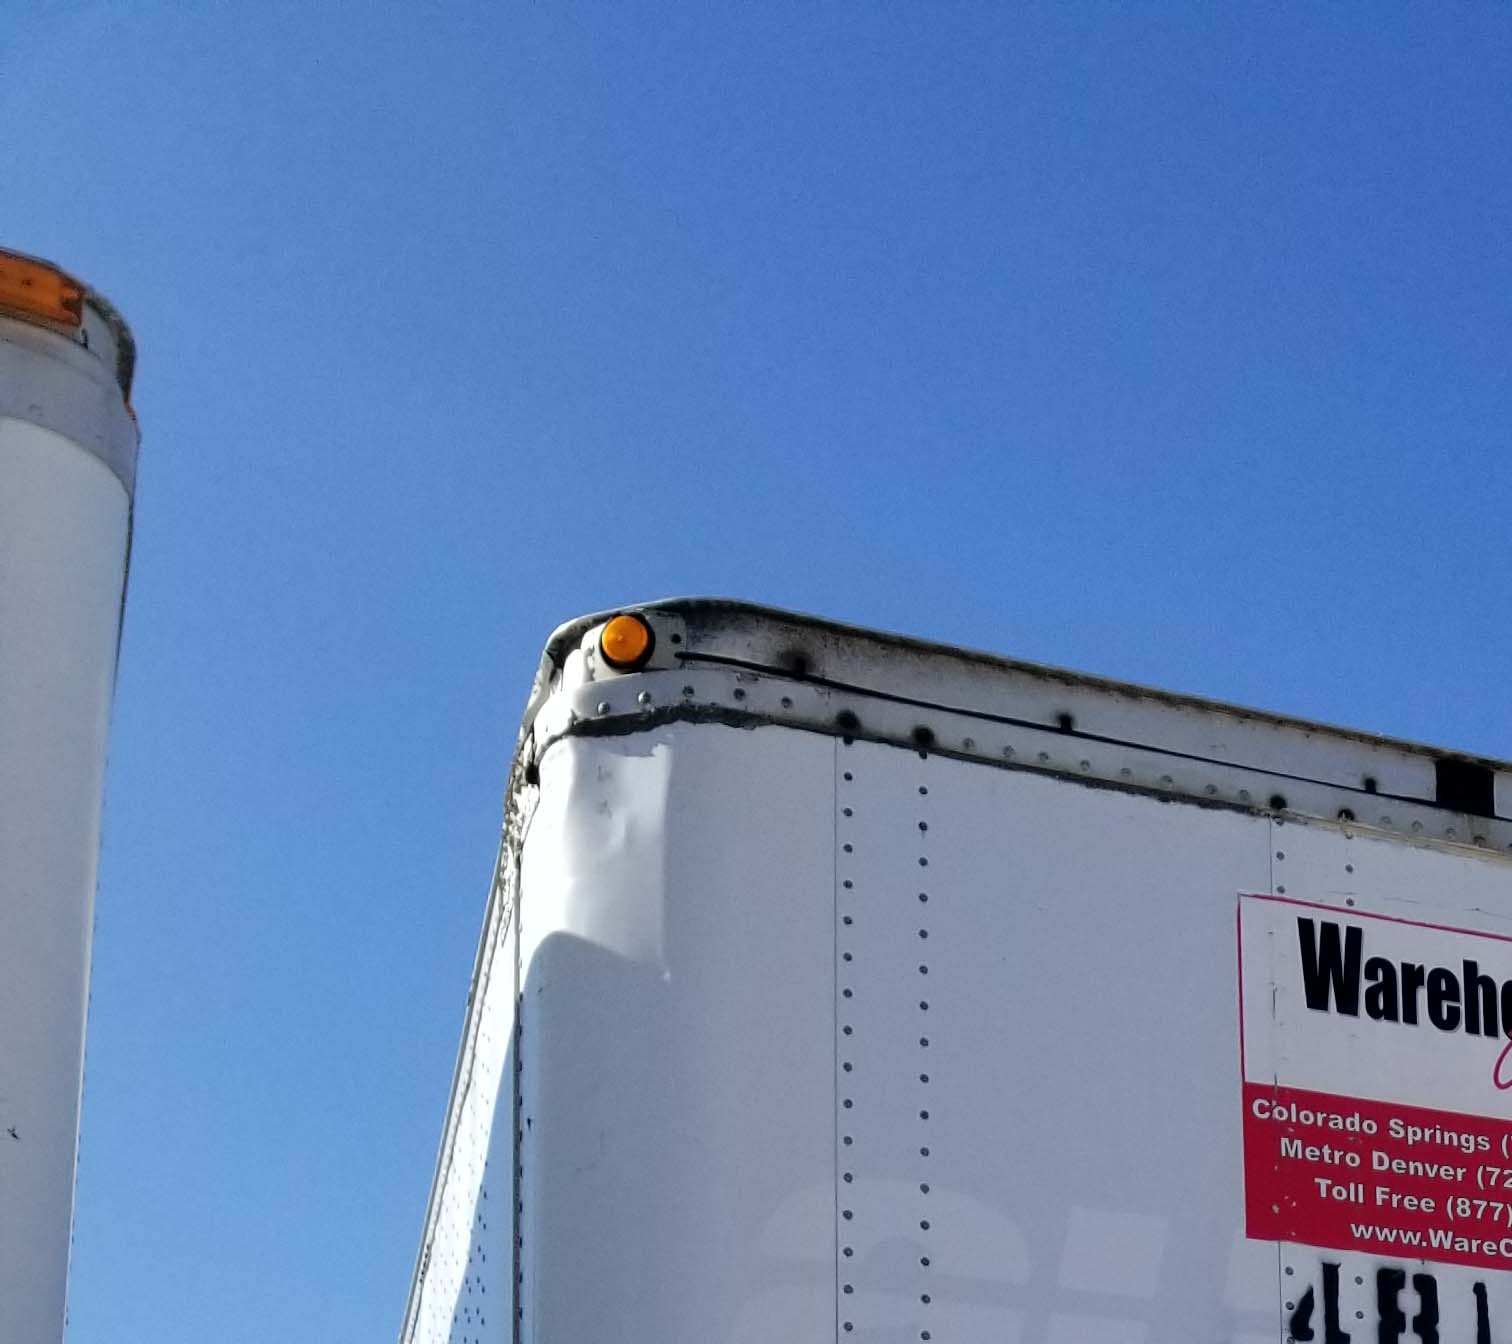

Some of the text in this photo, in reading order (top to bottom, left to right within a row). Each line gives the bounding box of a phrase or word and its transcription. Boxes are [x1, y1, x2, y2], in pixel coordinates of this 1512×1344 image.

[1252, 1099, 1378, 1135] Colorado
[1389, 1118, 1491, 1153] Springs
[1280, 1138, 1361, 1169] Metro
[1372, 1150, 1467, 1184] Denver
[1315, 1178, 1364, 1204] Toll
[1376, 1186, 1436, 1214] Free
